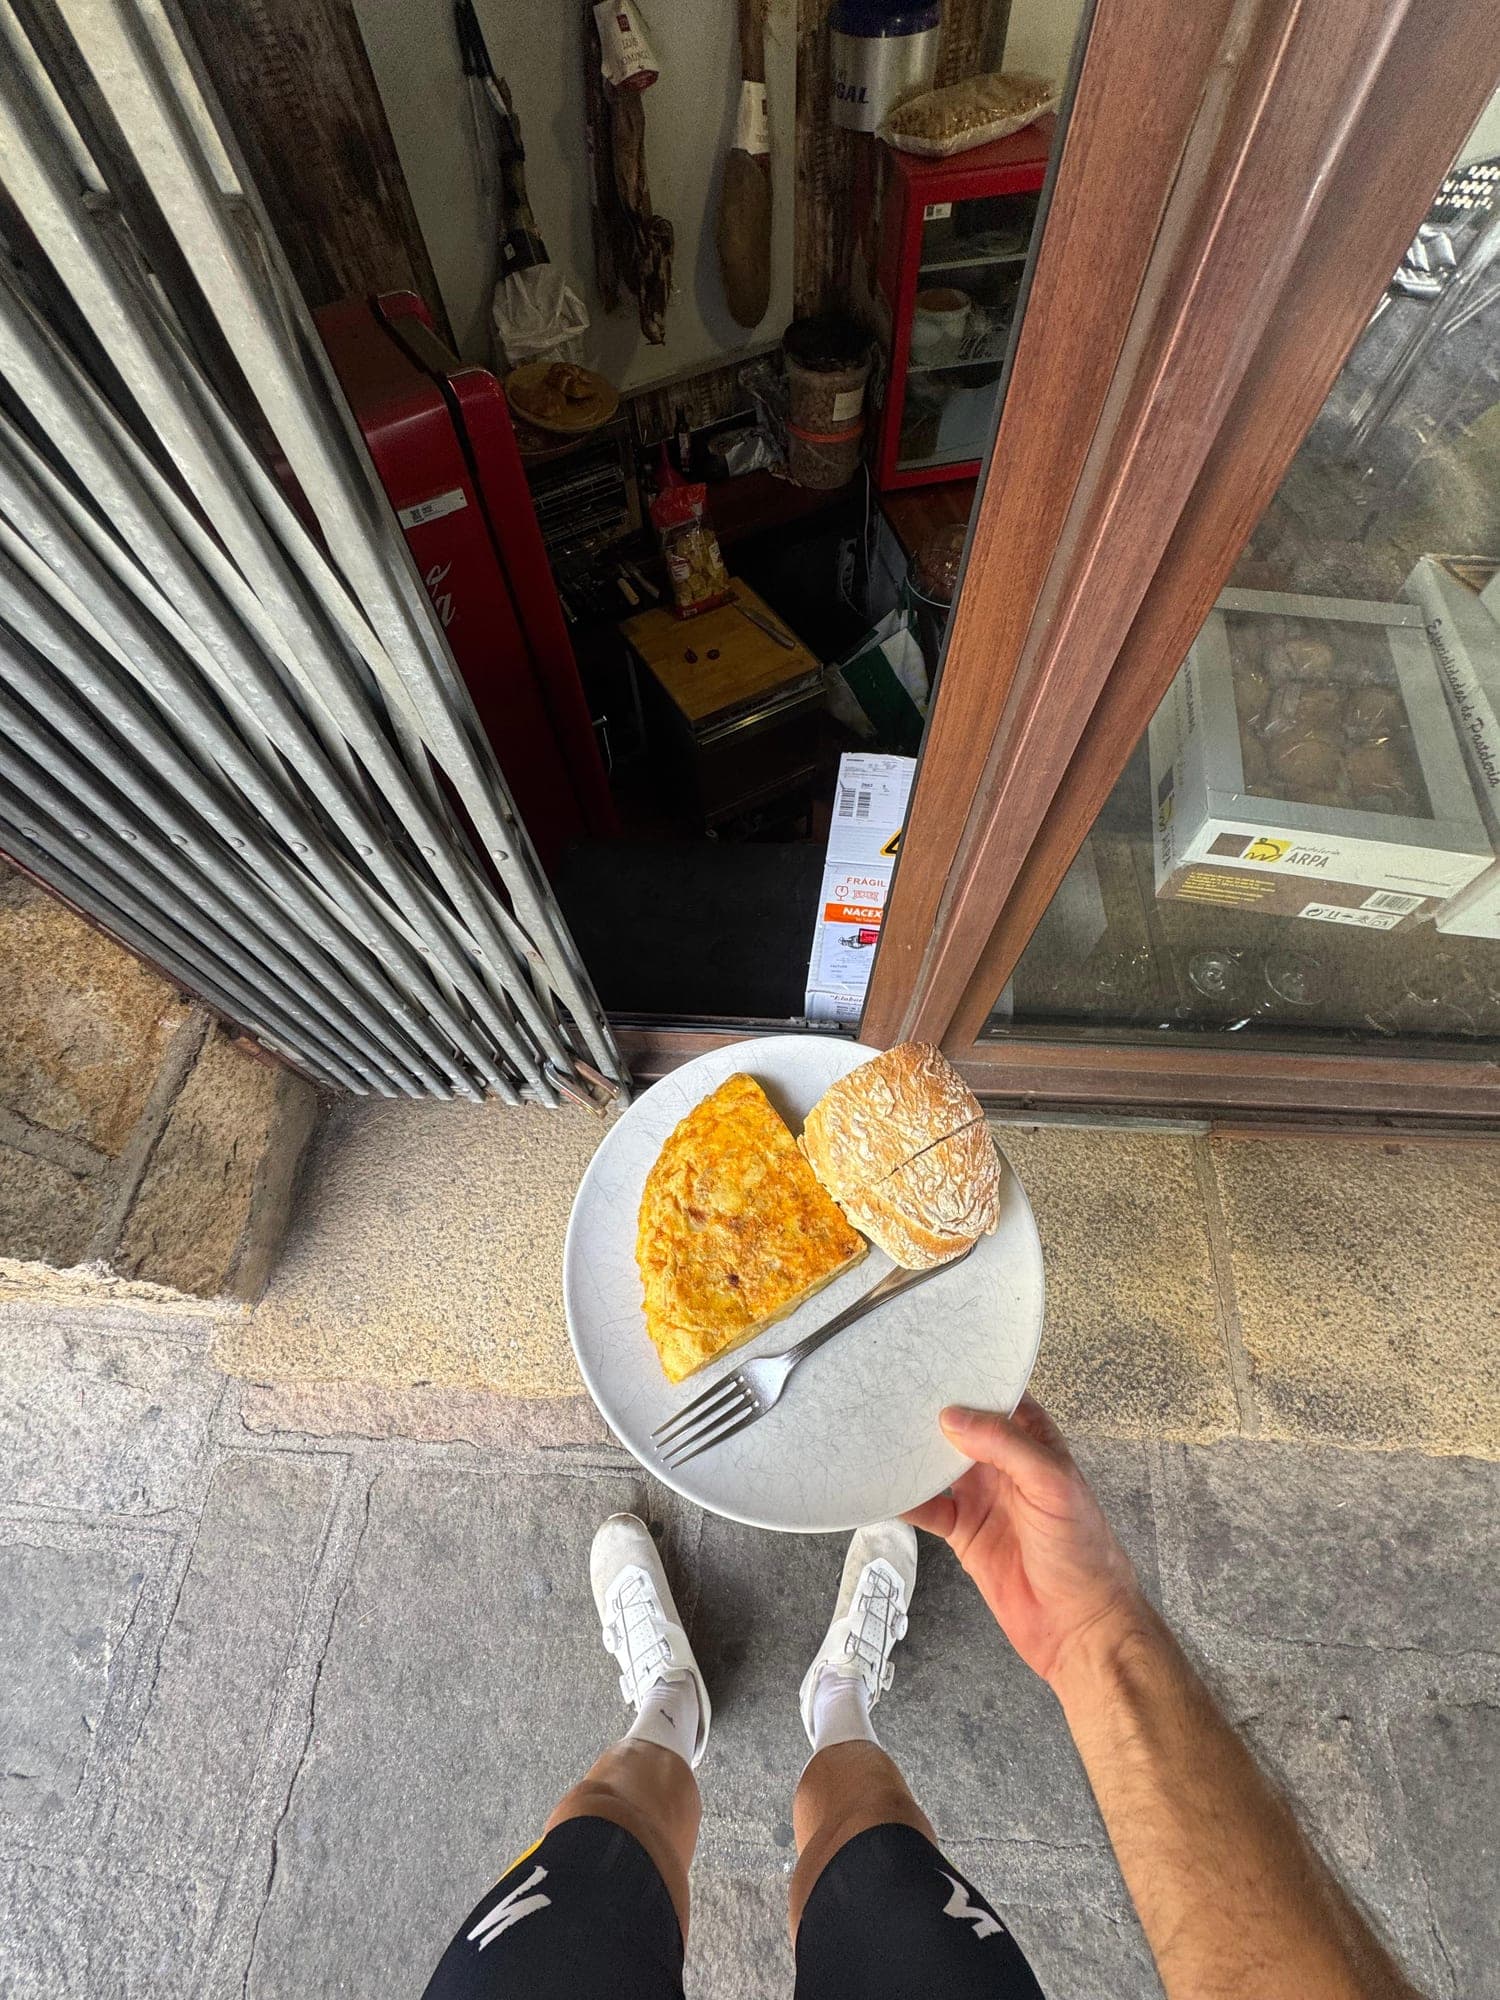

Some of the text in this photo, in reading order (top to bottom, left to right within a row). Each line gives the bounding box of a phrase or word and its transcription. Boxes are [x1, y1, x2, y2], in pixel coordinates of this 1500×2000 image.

[1460, 705, 1475, 721] de
[1285, 852, 1330, 868] ARPA
[846, 876, 887, 888] FRÁGIL
[842, 906, 884, 919] NACEX
